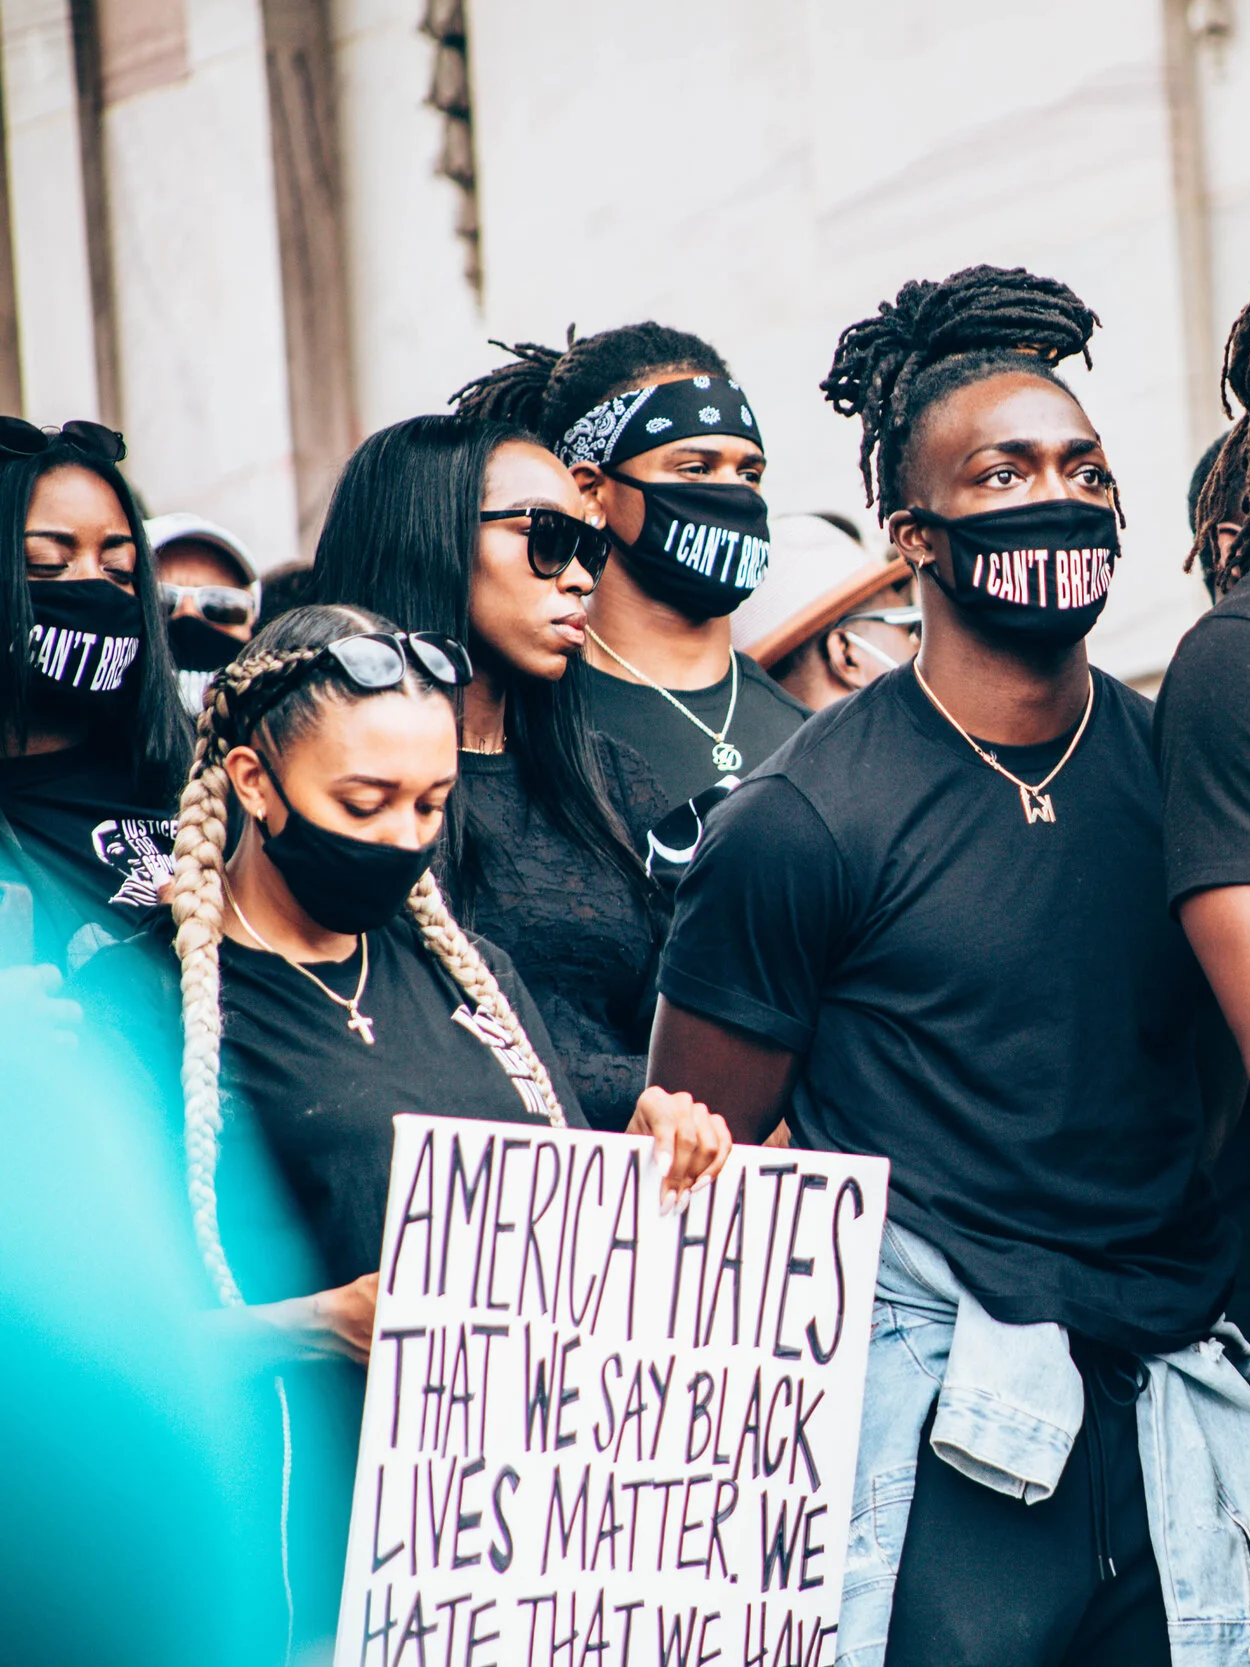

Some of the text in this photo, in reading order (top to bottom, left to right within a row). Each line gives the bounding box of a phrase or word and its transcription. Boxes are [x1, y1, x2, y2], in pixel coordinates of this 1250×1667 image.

[663, 520, 679, 552] I
[676, 523, 740, 583] CAN'T
[972, 553, 984, 588] I
[986, 548, 1049, 608] CAN'T
[121, 819, 180, 841] JUSTICE
[128, 836, 160, 857] FOR
[386, 1127, 865, 1366] AMERICA HATES
[380, 1320, 826, 1494] THAT WE SAY BLACK
[370, 1454, 829, 1594] LIVES MATTER. WE
